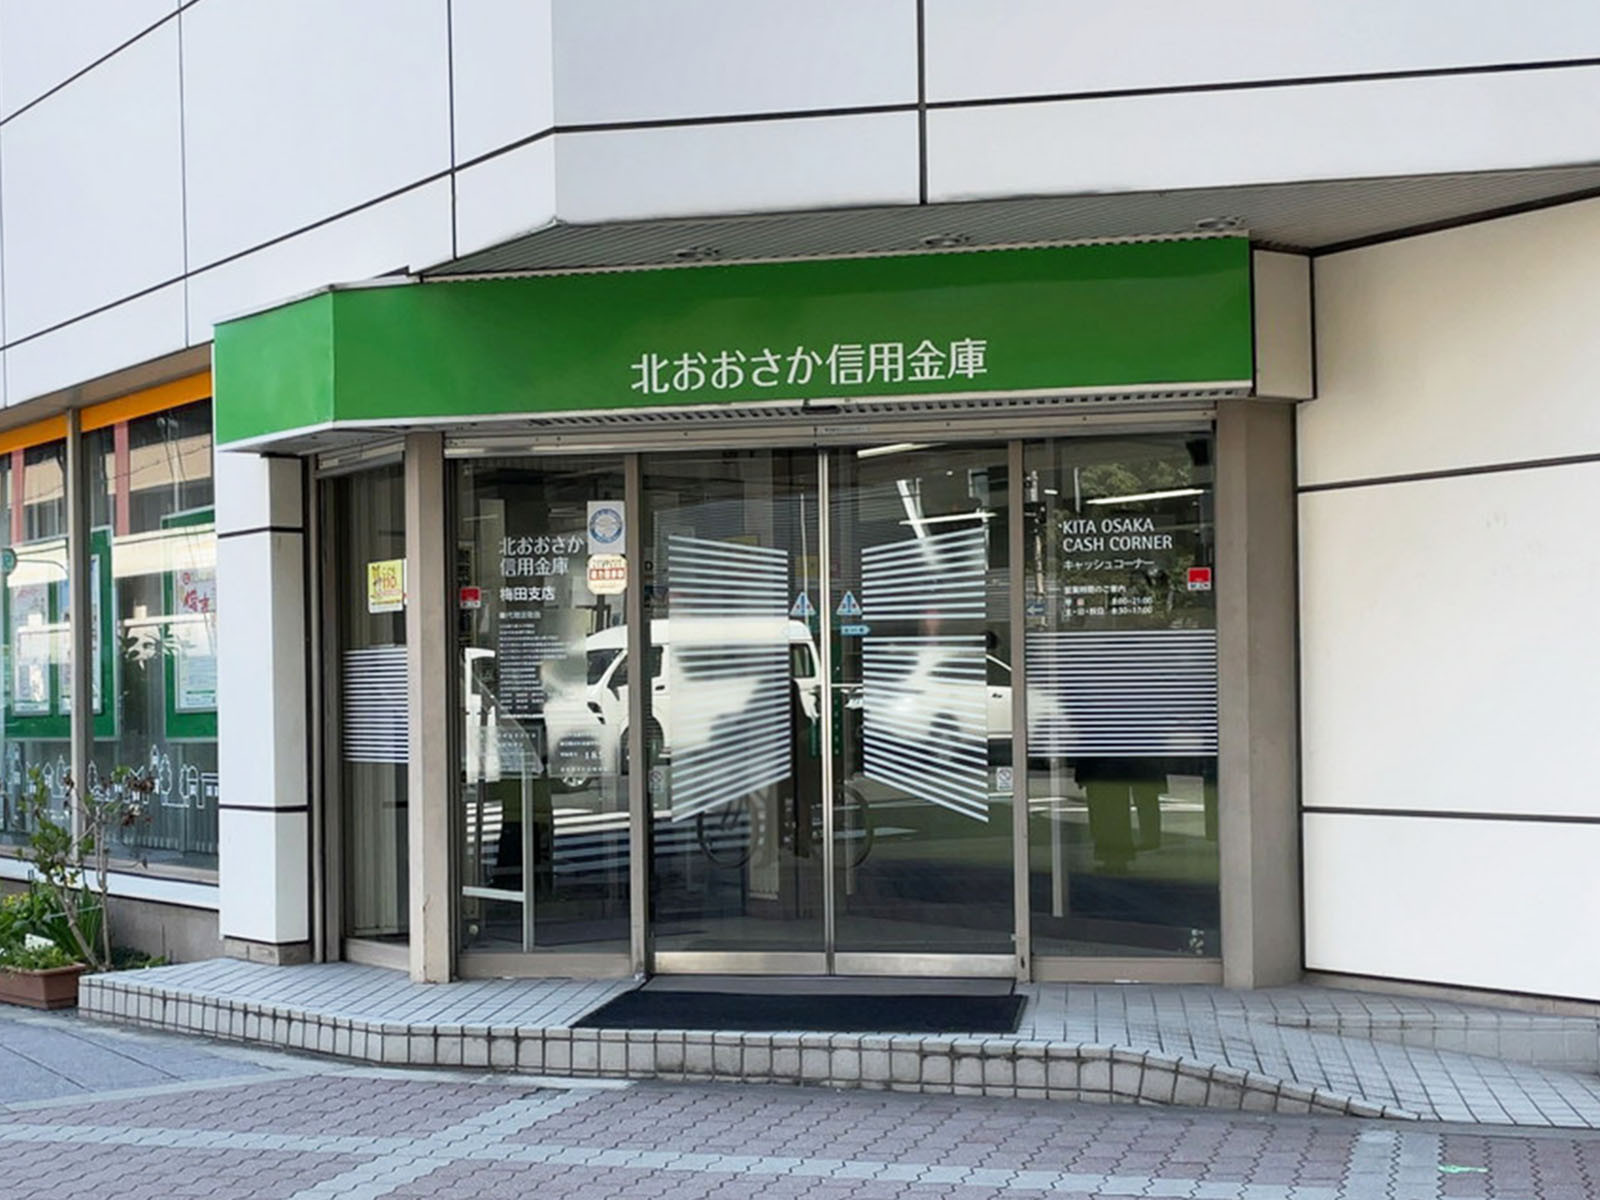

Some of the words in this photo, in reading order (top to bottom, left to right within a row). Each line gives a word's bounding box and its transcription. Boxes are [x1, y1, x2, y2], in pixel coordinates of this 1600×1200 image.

[630, 338, 988, 395] 北おおさか信用金庫
[1062, 519, 1097, 534] KITA
[1101, 518, 1155, 533] OSAKA
[499, 535, 584, 557] 北おおさか
[1062, 537, 1105, 553] CASH
[1109, 535, 1173, 551] CORNER
[500, 556, 570, 577] 信用金庫
[1063, 558, 1154, 571] キャッシュコーナー
[500, 586, 557, 602] 梅田支店
